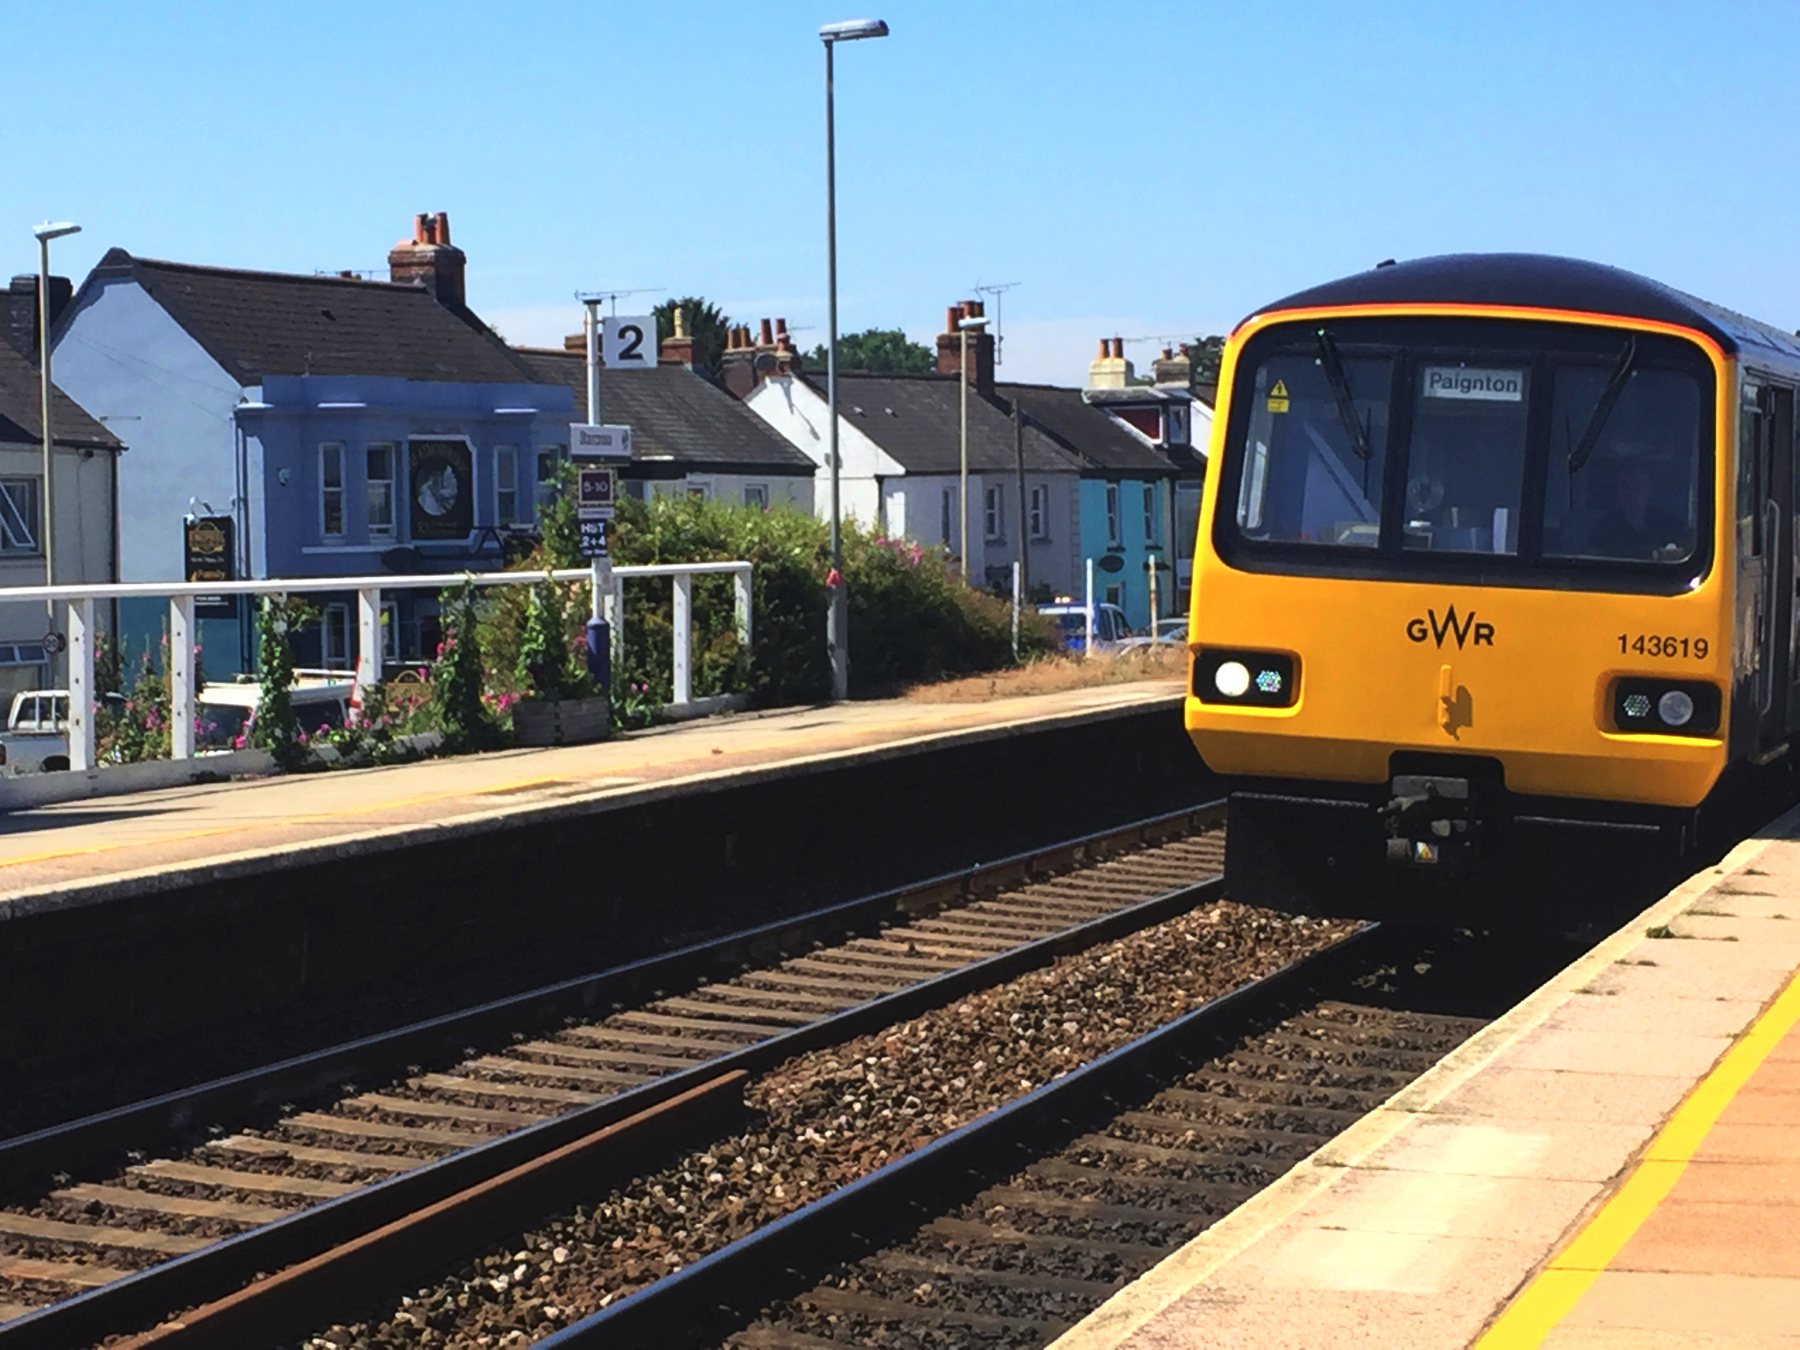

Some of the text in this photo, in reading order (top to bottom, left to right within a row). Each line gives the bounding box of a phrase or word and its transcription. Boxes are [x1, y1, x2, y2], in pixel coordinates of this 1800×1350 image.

[618, 324, 644, 360] 2
[1430, 372, 1518, 394] Paignton
[581, 522, 605, 534] HST
[582, 535, 606, 547] 2+4
[1406, 603, 1495, 651] GWR
[1617, 633, 1709, 660] 143619
